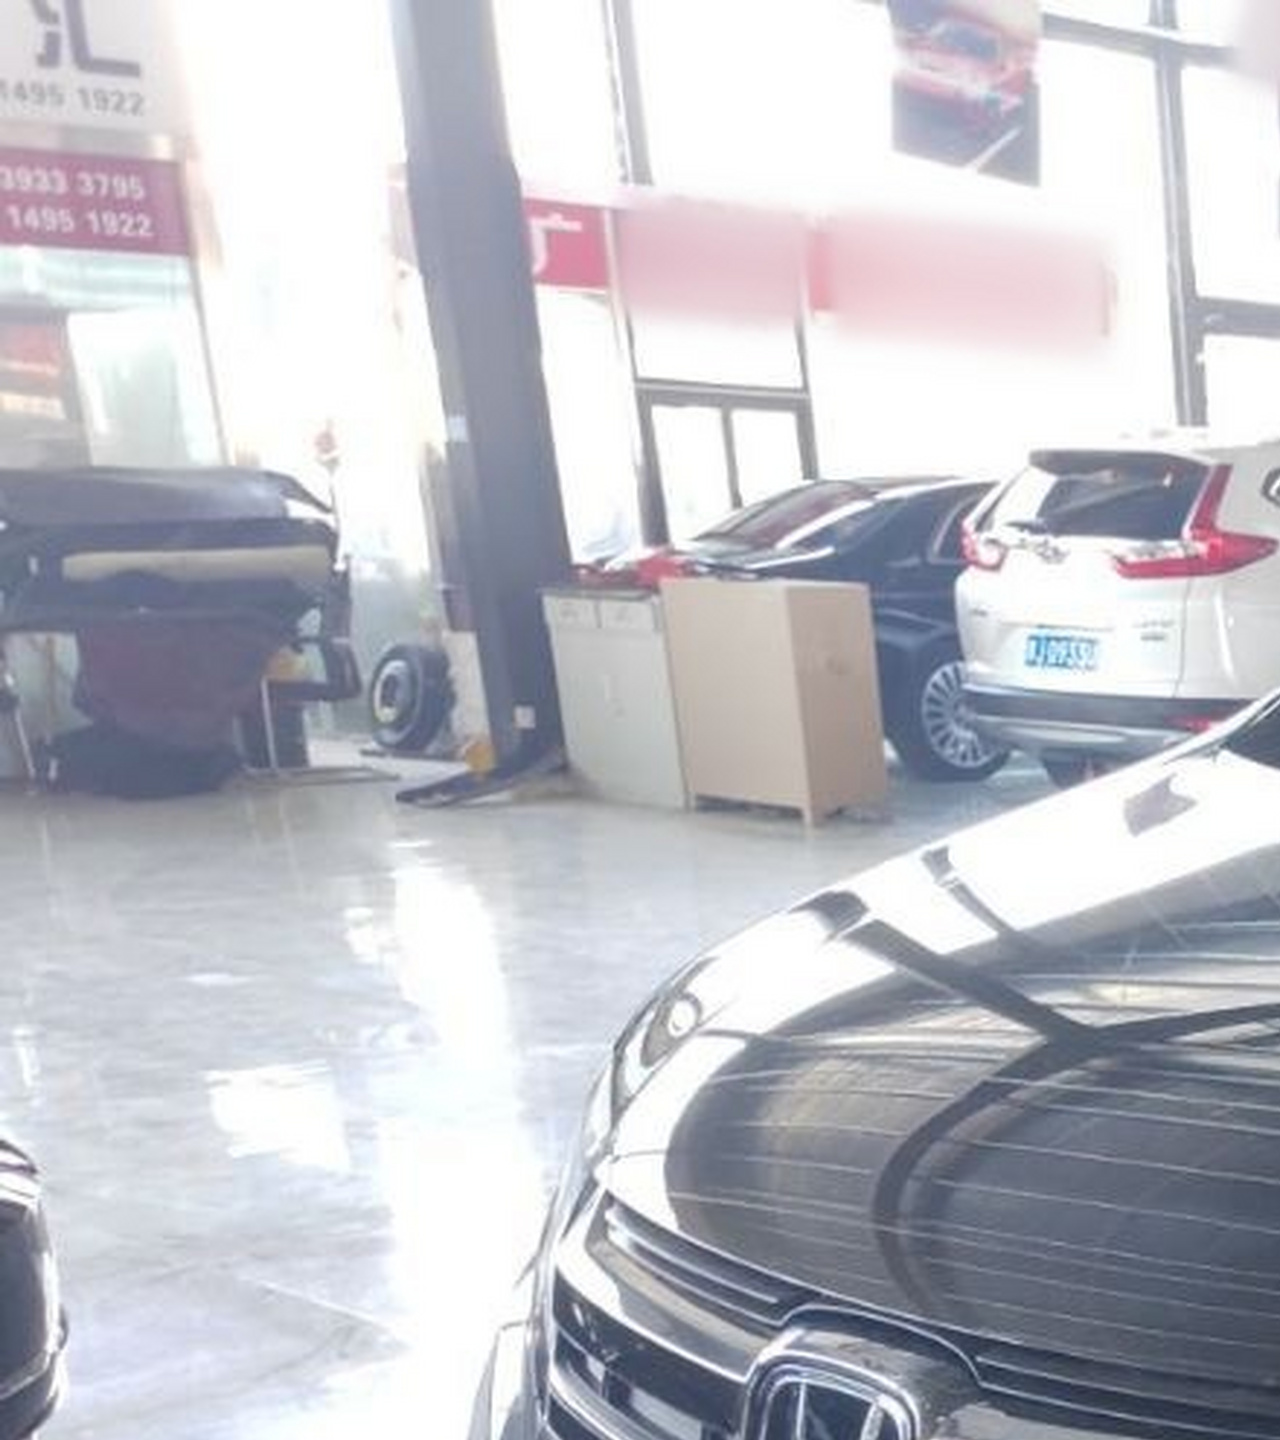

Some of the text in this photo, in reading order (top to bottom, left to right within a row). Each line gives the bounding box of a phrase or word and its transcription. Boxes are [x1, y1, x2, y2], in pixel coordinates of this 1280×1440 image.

[76, 86, 145, 117] 1922
[76, 171, 145, 200] 3795
[6, 205, 153, 238] 1495 1922
